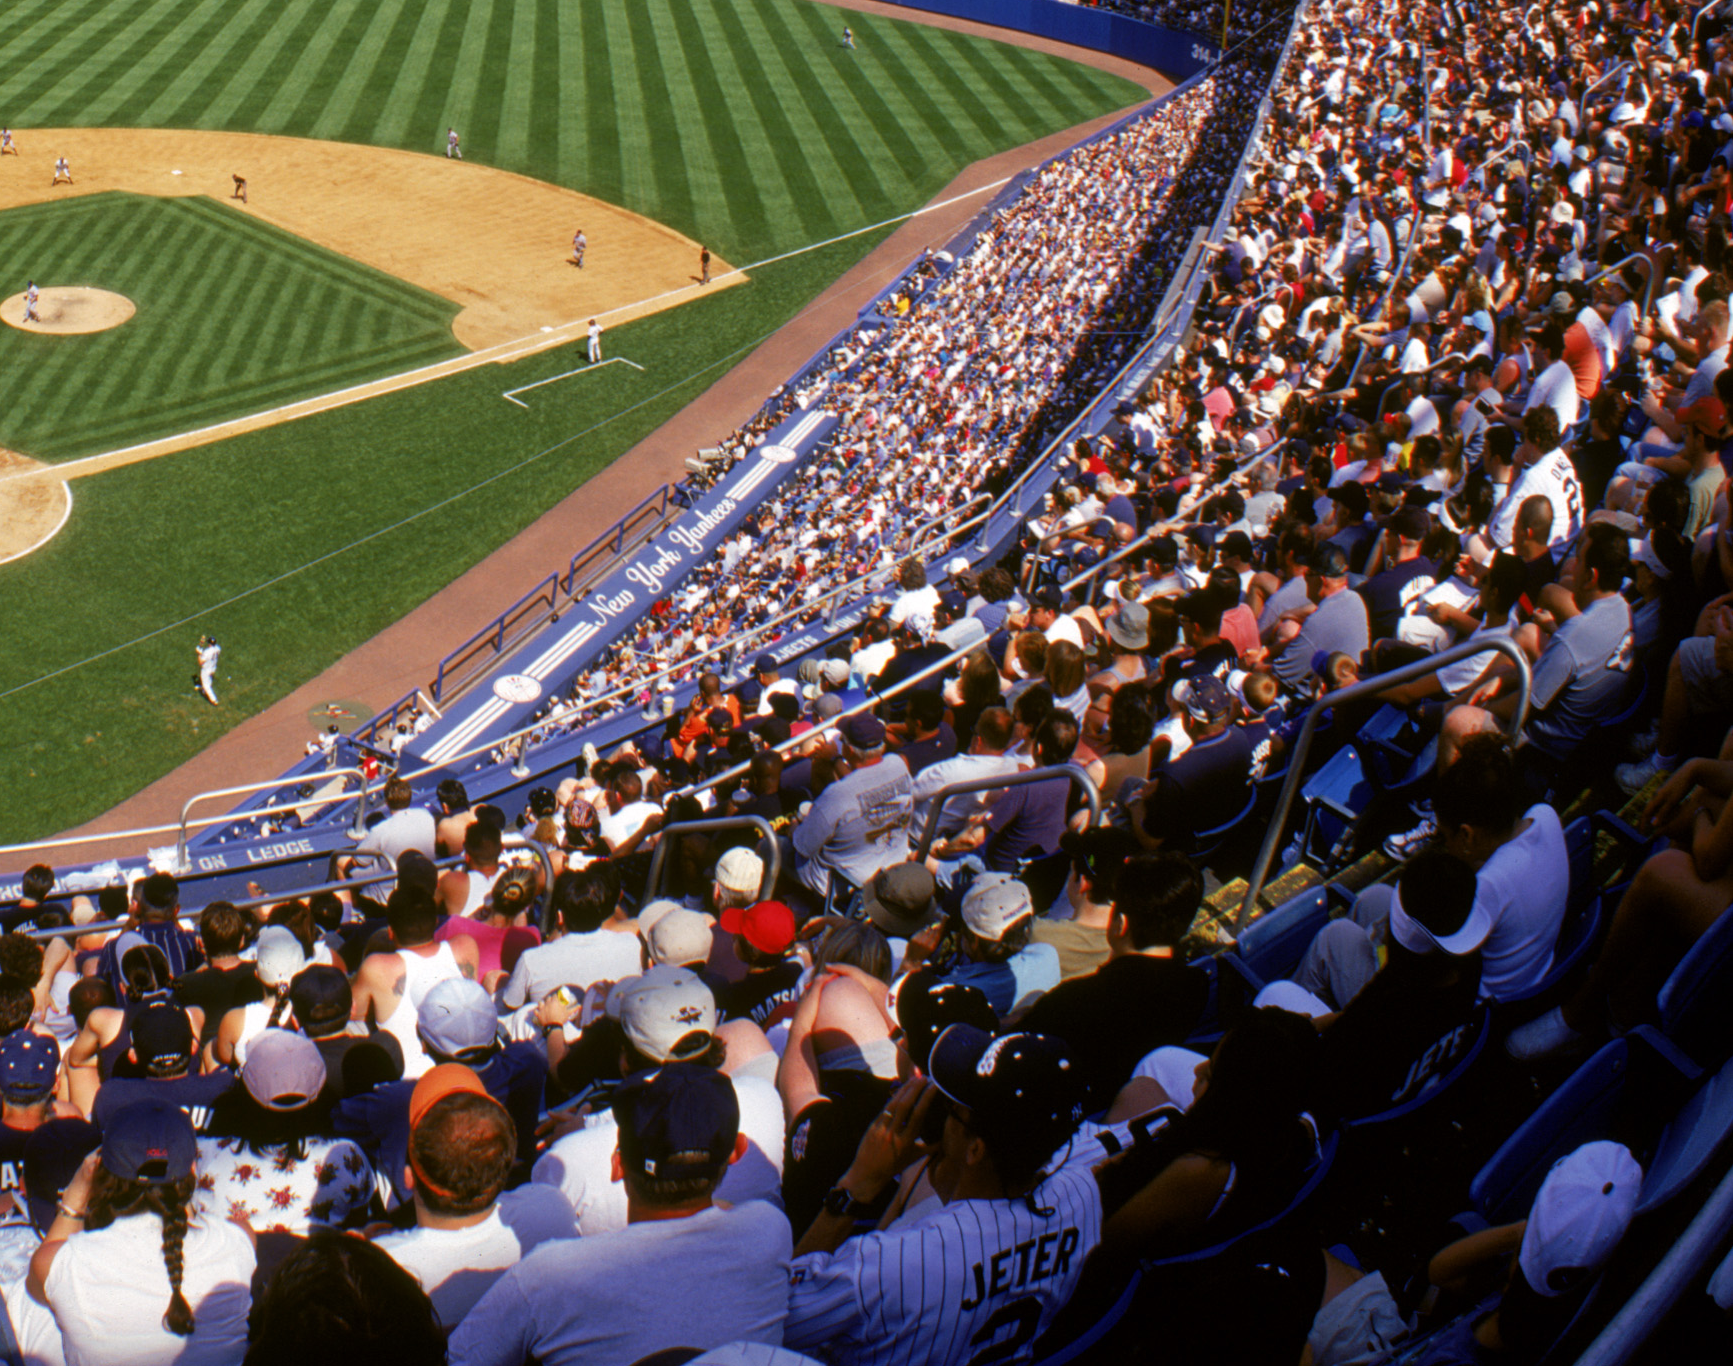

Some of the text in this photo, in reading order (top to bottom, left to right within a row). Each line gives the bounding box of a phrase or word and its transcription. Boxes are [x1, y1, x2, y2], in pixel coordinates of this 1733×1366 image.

[587, 497, 737, 628] New York Yankees
[197, 838, 316, 872] ON LEDGE
[960, 1226, 1080, 1311] JETER
